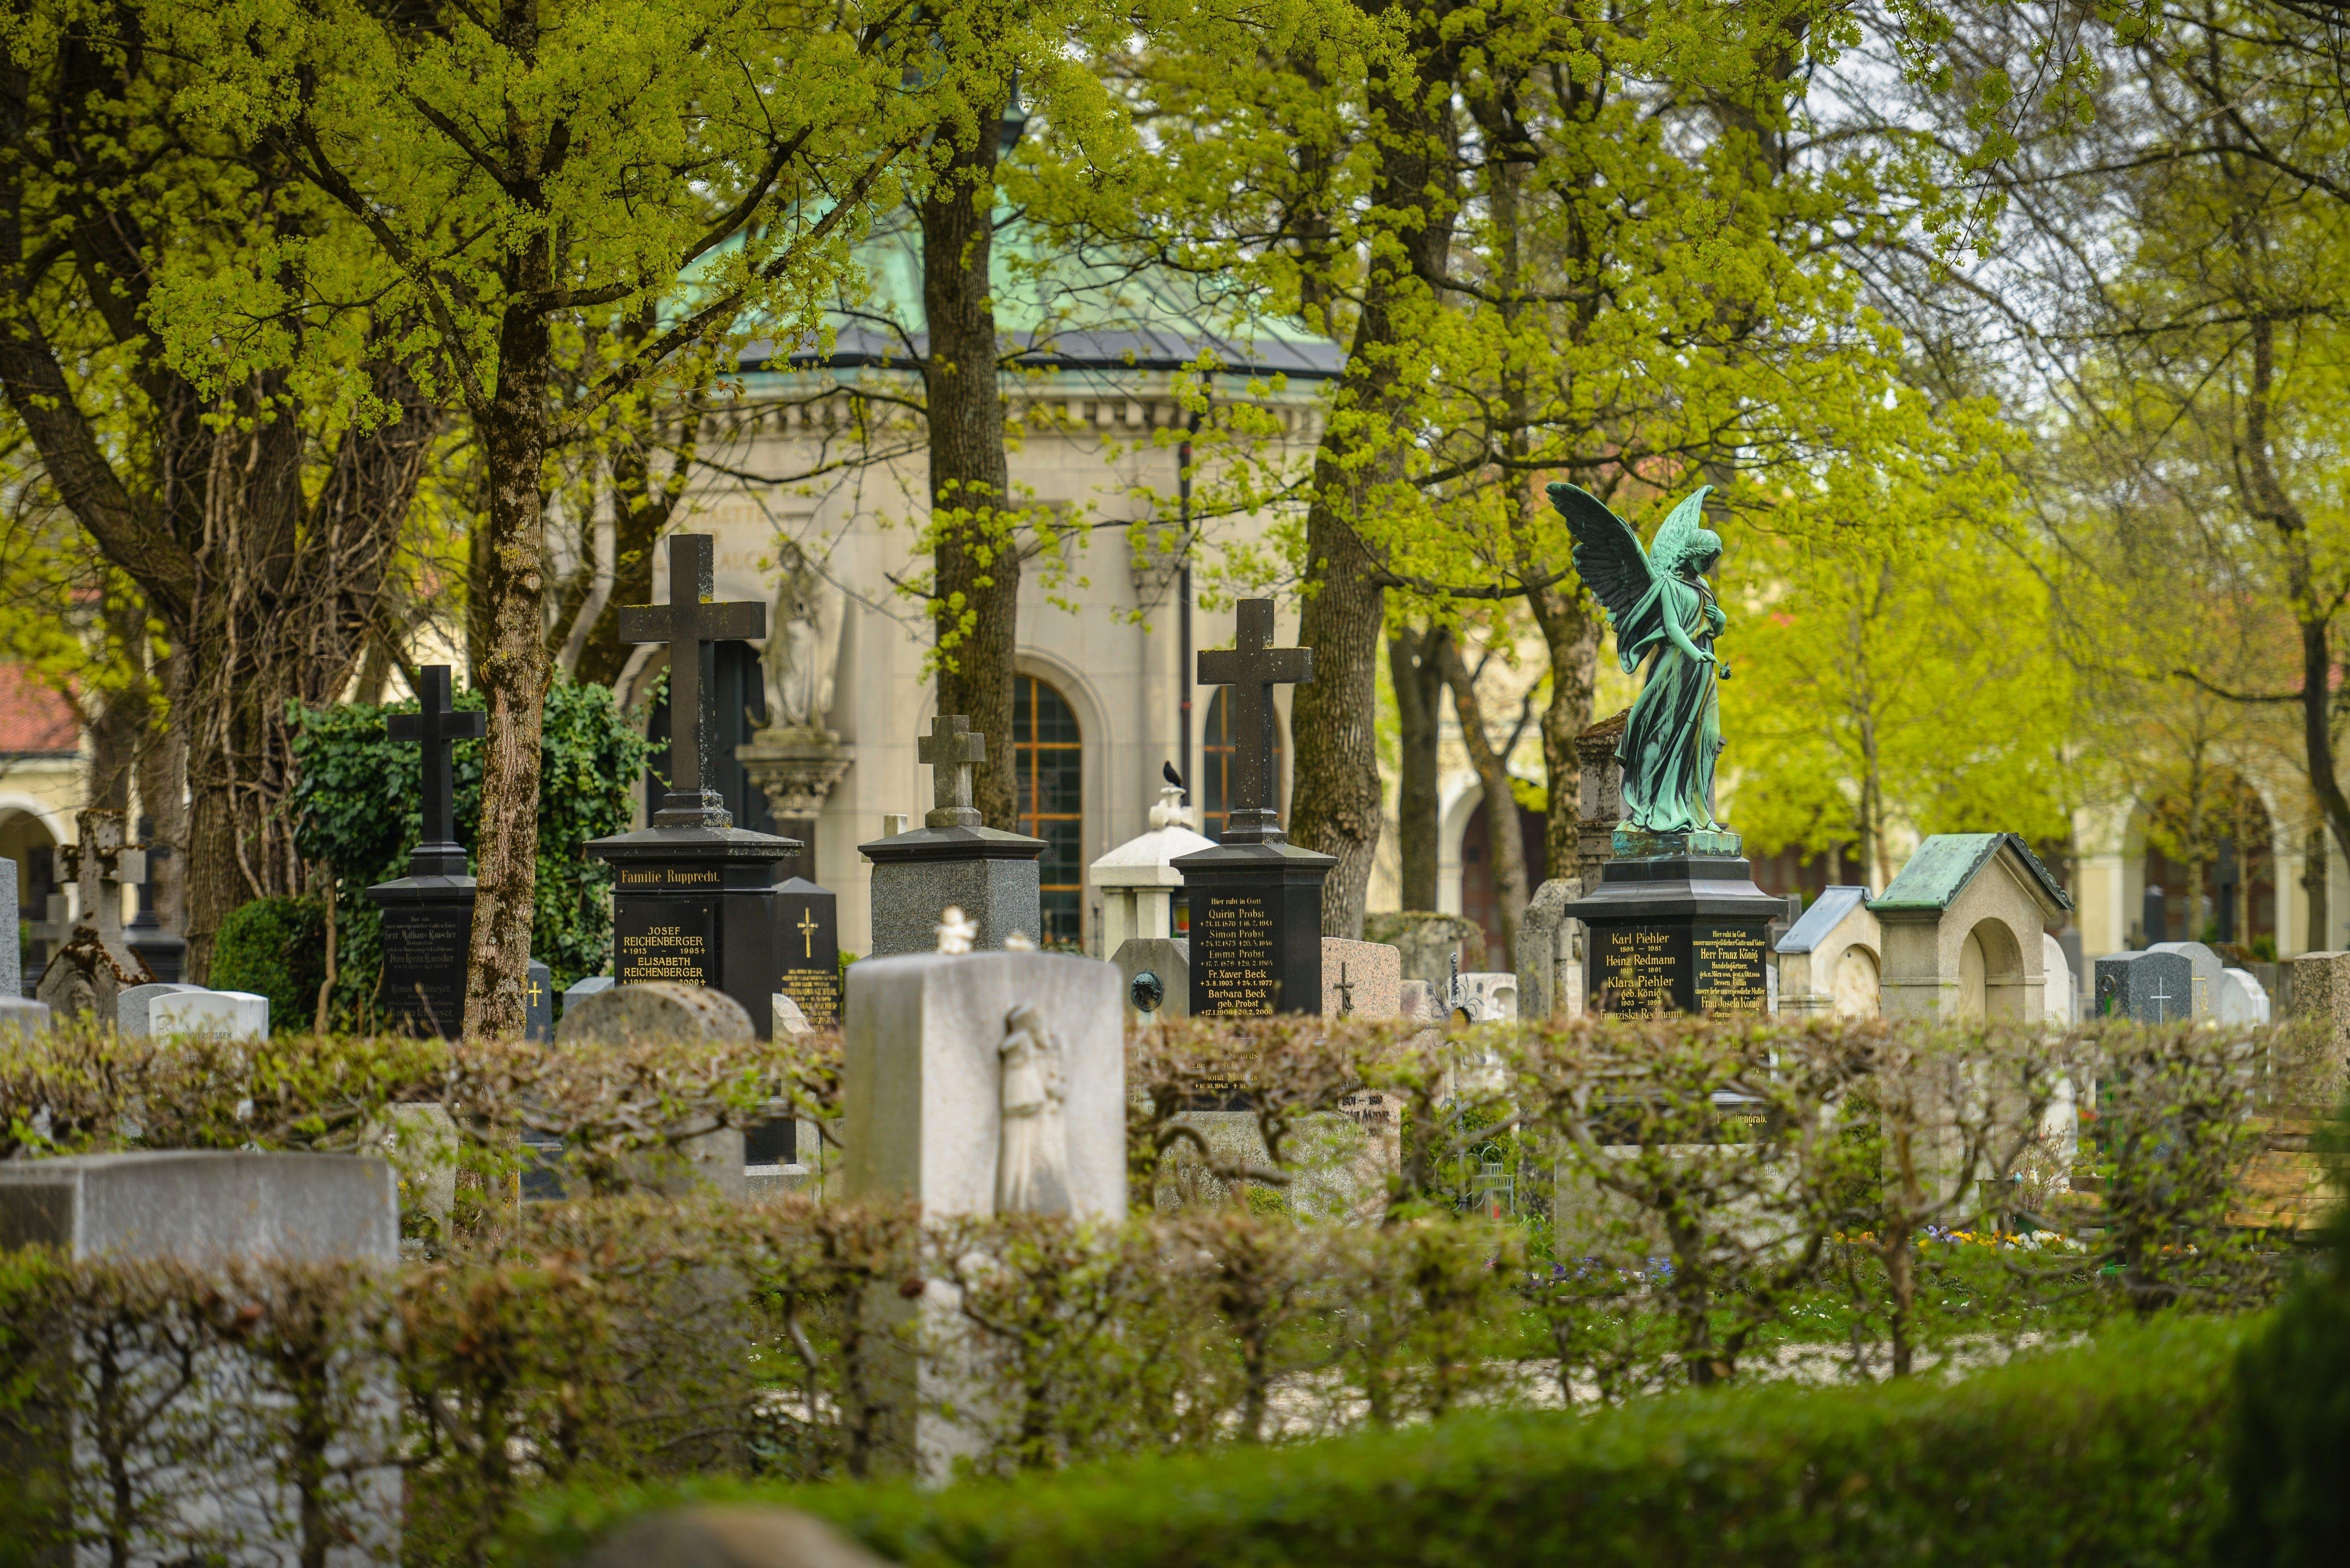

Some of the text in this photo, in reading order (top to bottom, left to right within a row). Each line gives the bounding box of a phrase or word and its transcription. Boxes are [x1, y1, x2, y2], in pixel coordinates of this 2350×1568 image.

[621, 869, 720, 884] Familie Rupprecht.
[1209, 909, 1264, 919] Quirin Probst
[647, 927, 681, 935] JOSEF
[1209, 929, 1264, 938] Simon Probst
[624, 936, 703, 946] REICHENBERGER
[1612, 932, 1669, 944] Karl Piehler
[1239, 950, 1264, 958] Probst
[1701, 948, 1758, 963] Herr Franz König
[638, 957, 691, 966] ELISABETH
[1606, 954, 1676, 966] Heinz Redmann
[624, 967, 703, 977] REICHENBERGER
[1219, 970, 1242, 978] Xaver
[1245, 969, 1267, 978] Beck
[1608, 975, 1674, 988] Klara Piehler
[1208, 989, 1267, 998] Barbara Beck
[1621, 988, 1661, 1000] geb. König
[1217, 1000, 1234, 1009] geb.
[1701, 997, 1760, 1011] Frau Josefa König
